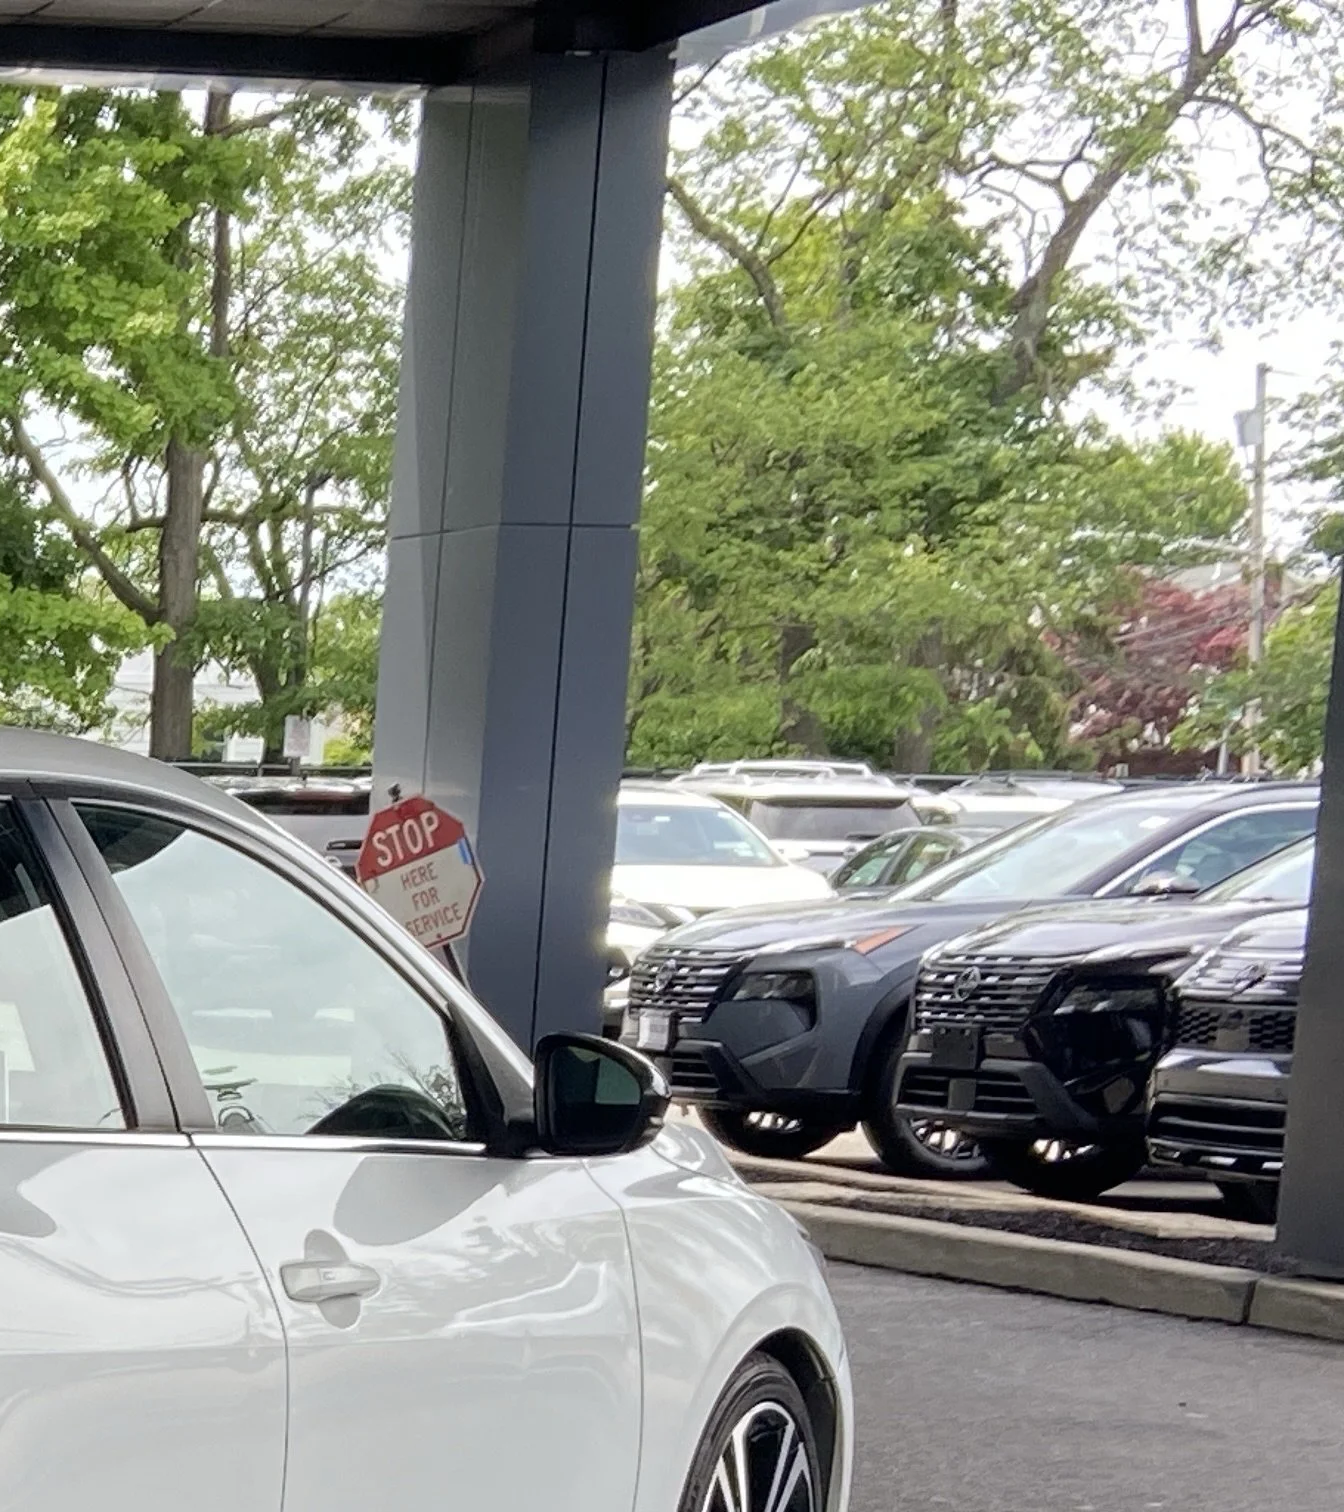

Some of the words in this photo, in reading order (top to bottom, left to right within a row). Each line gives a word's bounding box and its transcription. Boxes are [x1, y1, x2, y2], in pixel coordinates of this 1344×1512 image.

[372, 811, 439, 867] STOP
[400, 862, 438, 891] HERE
[411, 887, 440, 912] FOR
[405, 902, 463, 937] SERVICE
